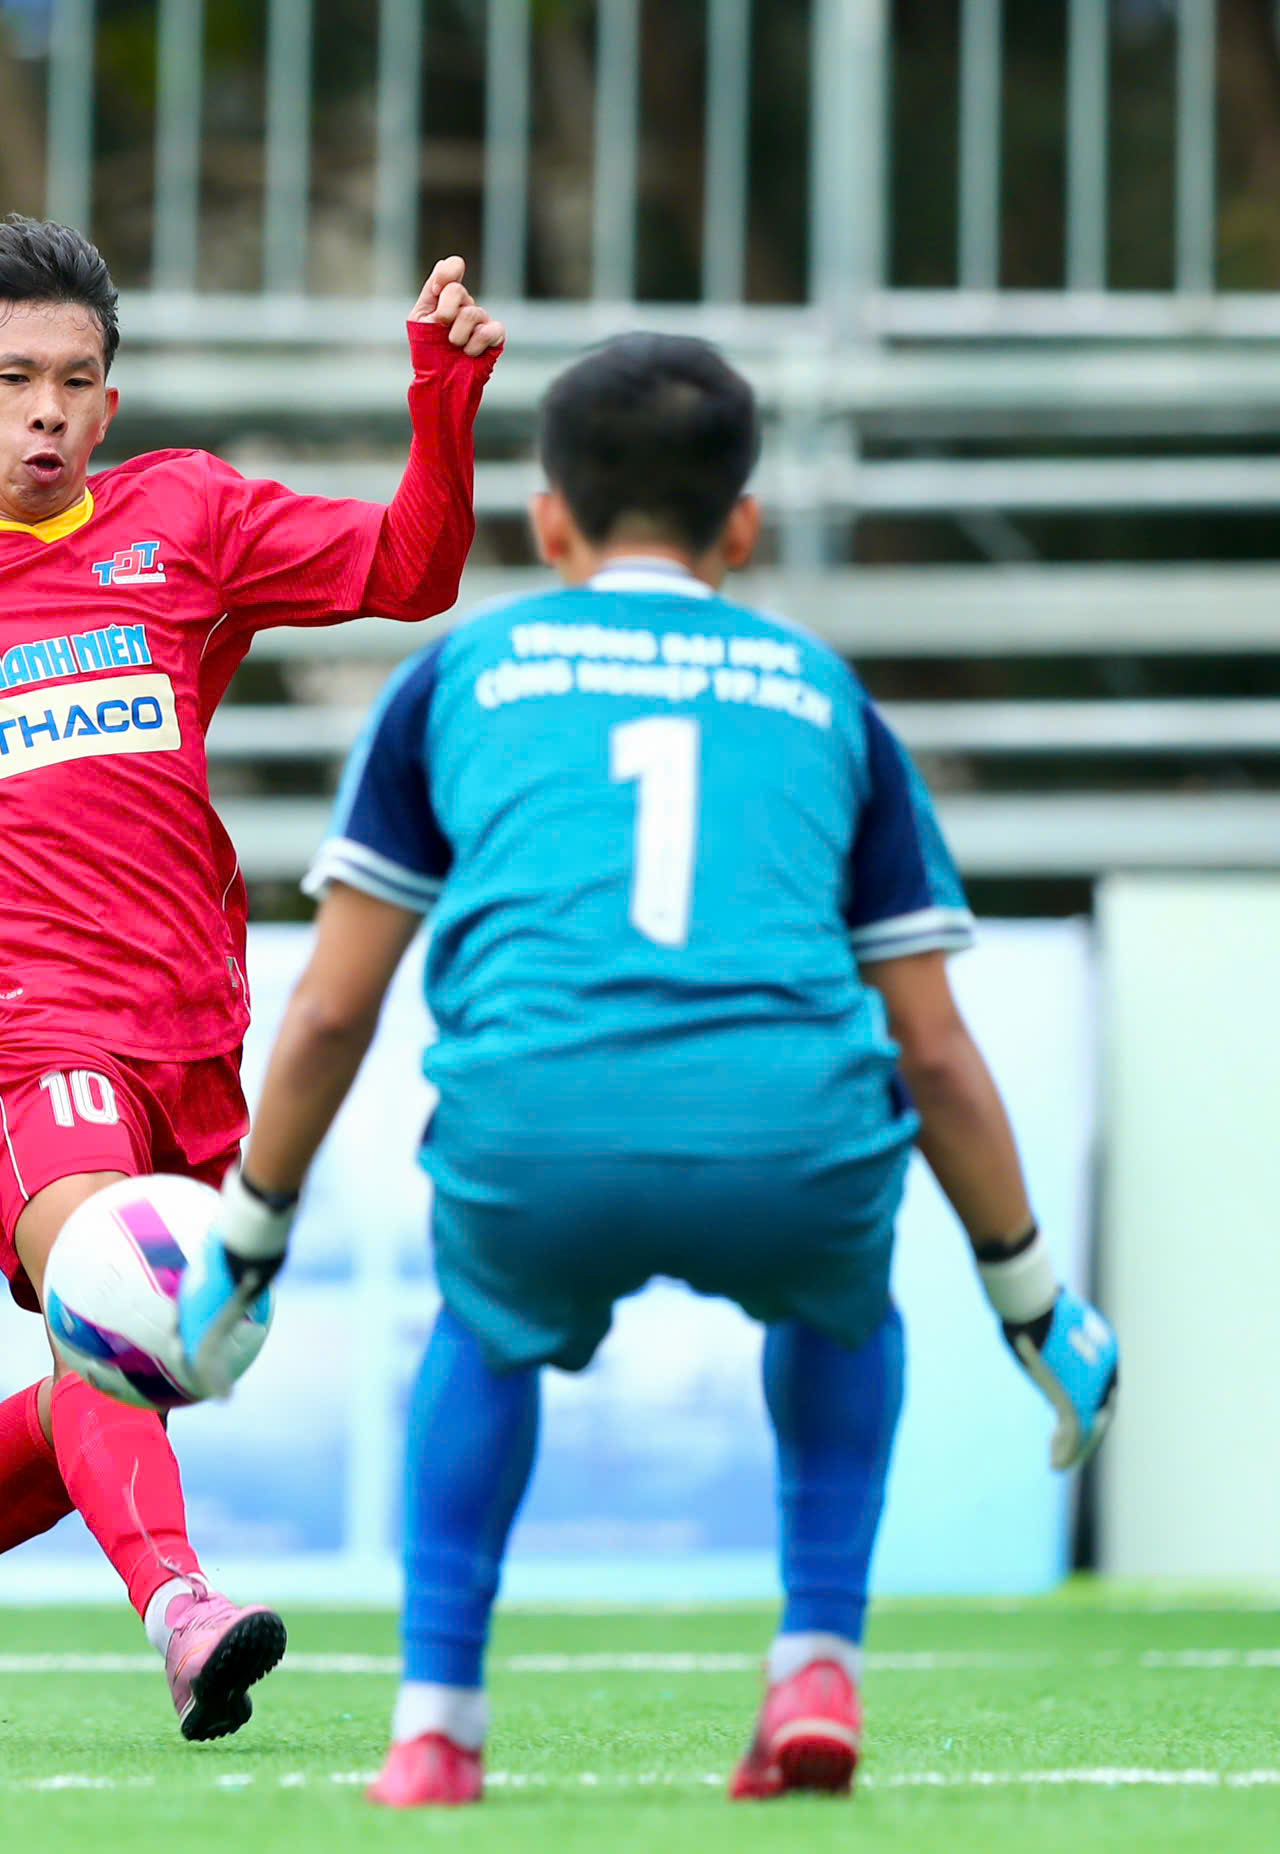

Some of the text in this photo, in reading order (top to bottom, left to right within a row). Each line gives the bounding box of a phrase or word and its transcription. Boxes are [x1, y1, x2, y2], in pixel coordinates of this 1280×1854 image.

[70, 624, 152, 673] NIÊN
[609, 714, 700, 947] 1
[39, 1070, 120, 1127] 10
